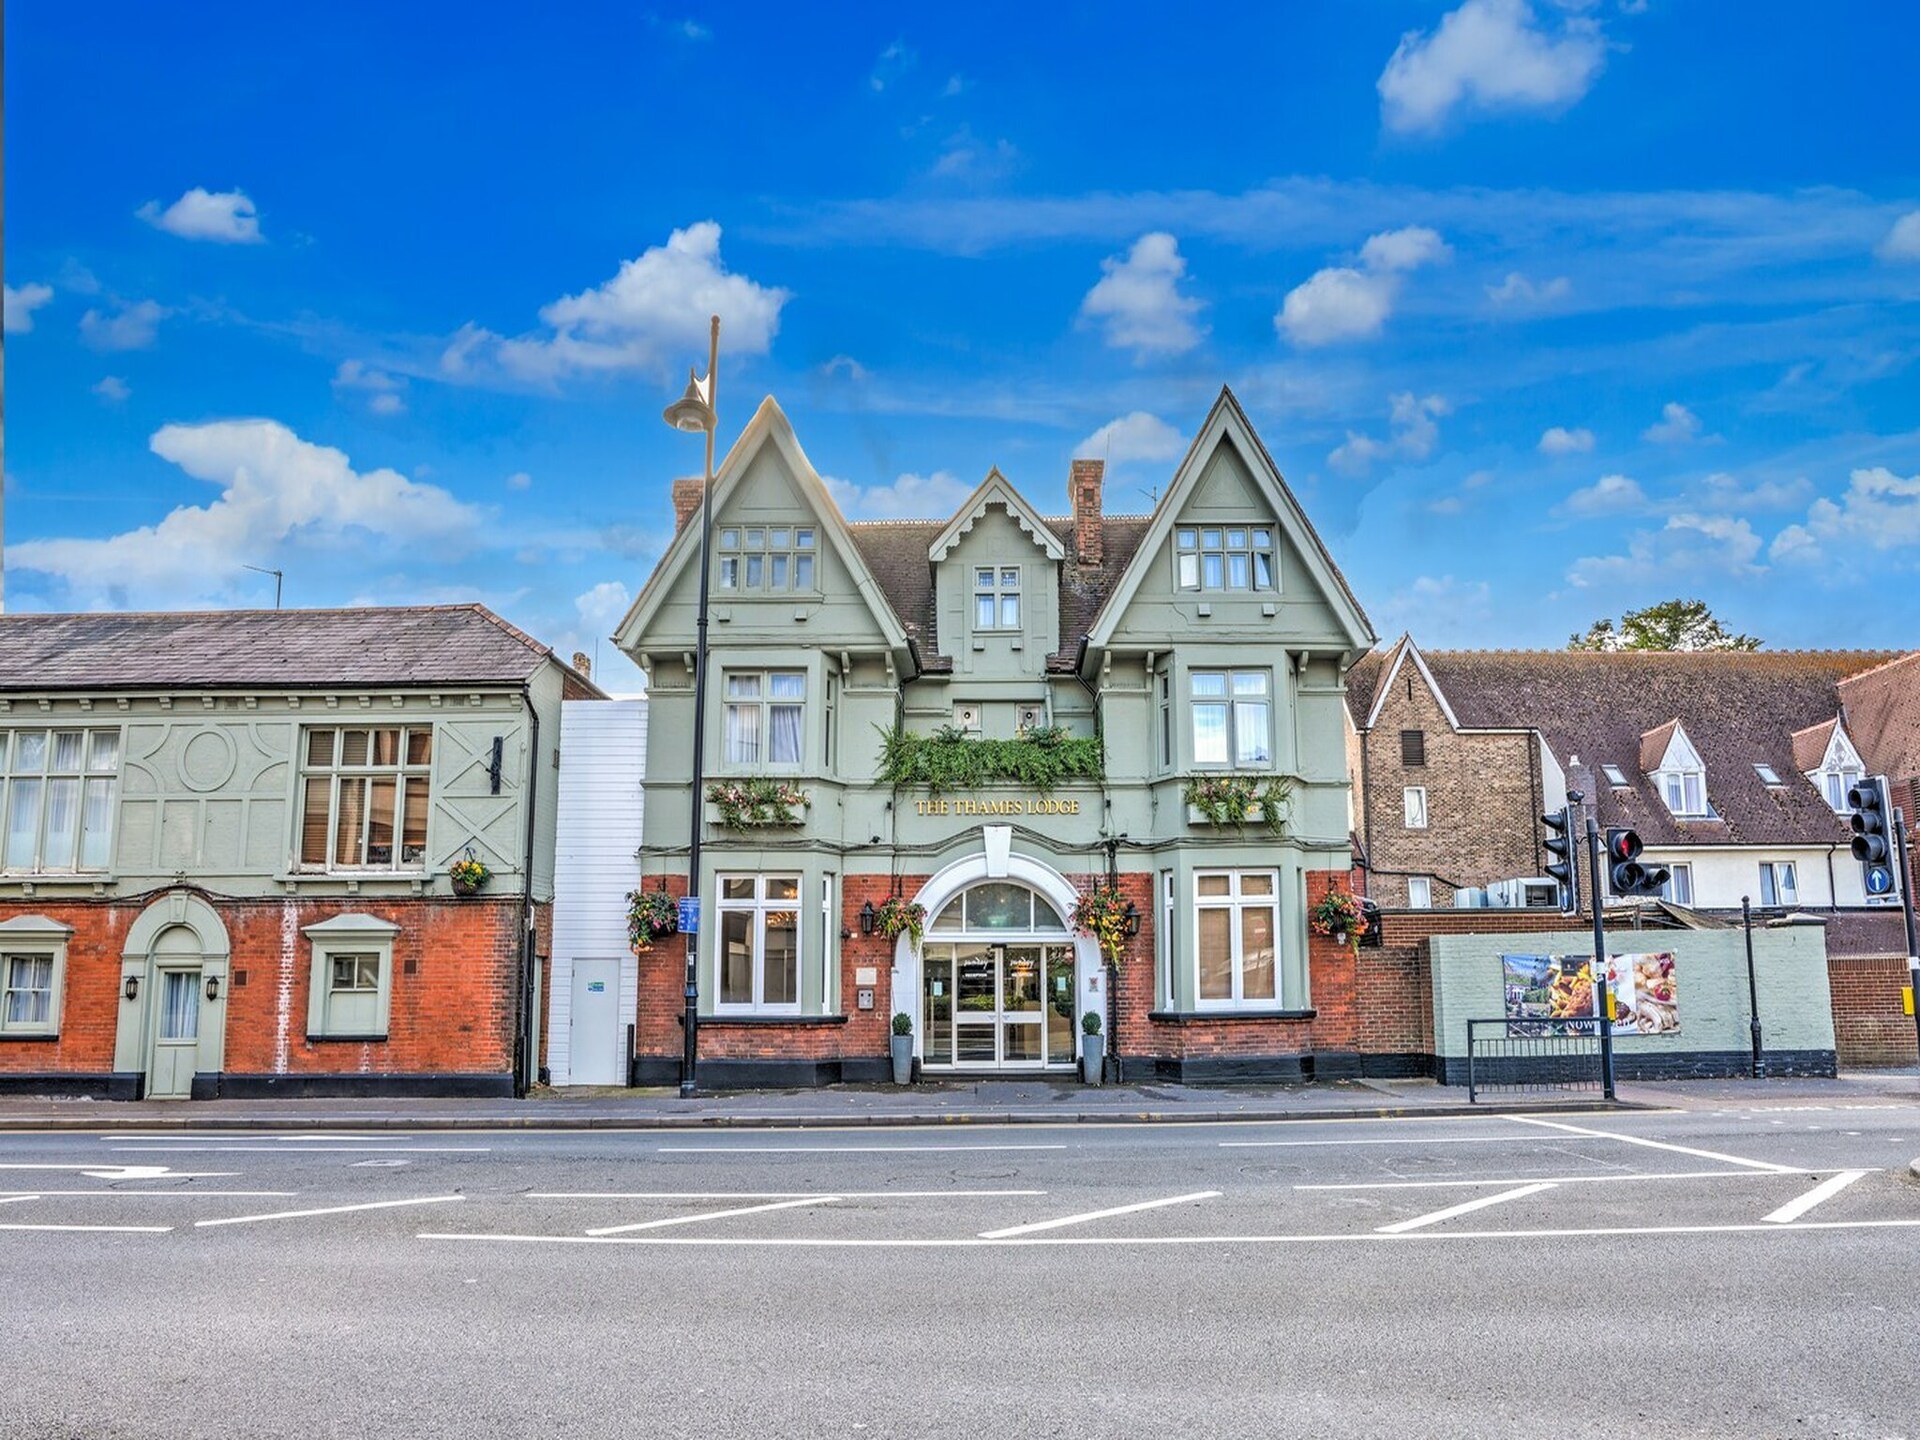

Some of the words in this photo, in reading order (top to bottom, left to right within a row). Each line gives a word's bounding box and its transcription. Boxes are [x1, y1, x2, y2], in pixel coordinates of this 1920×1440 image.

[914, 799, 949, 816] THE
[953, 799, 1023, 816] THAMES
[1027, 799, 1080, 816] LODGE
